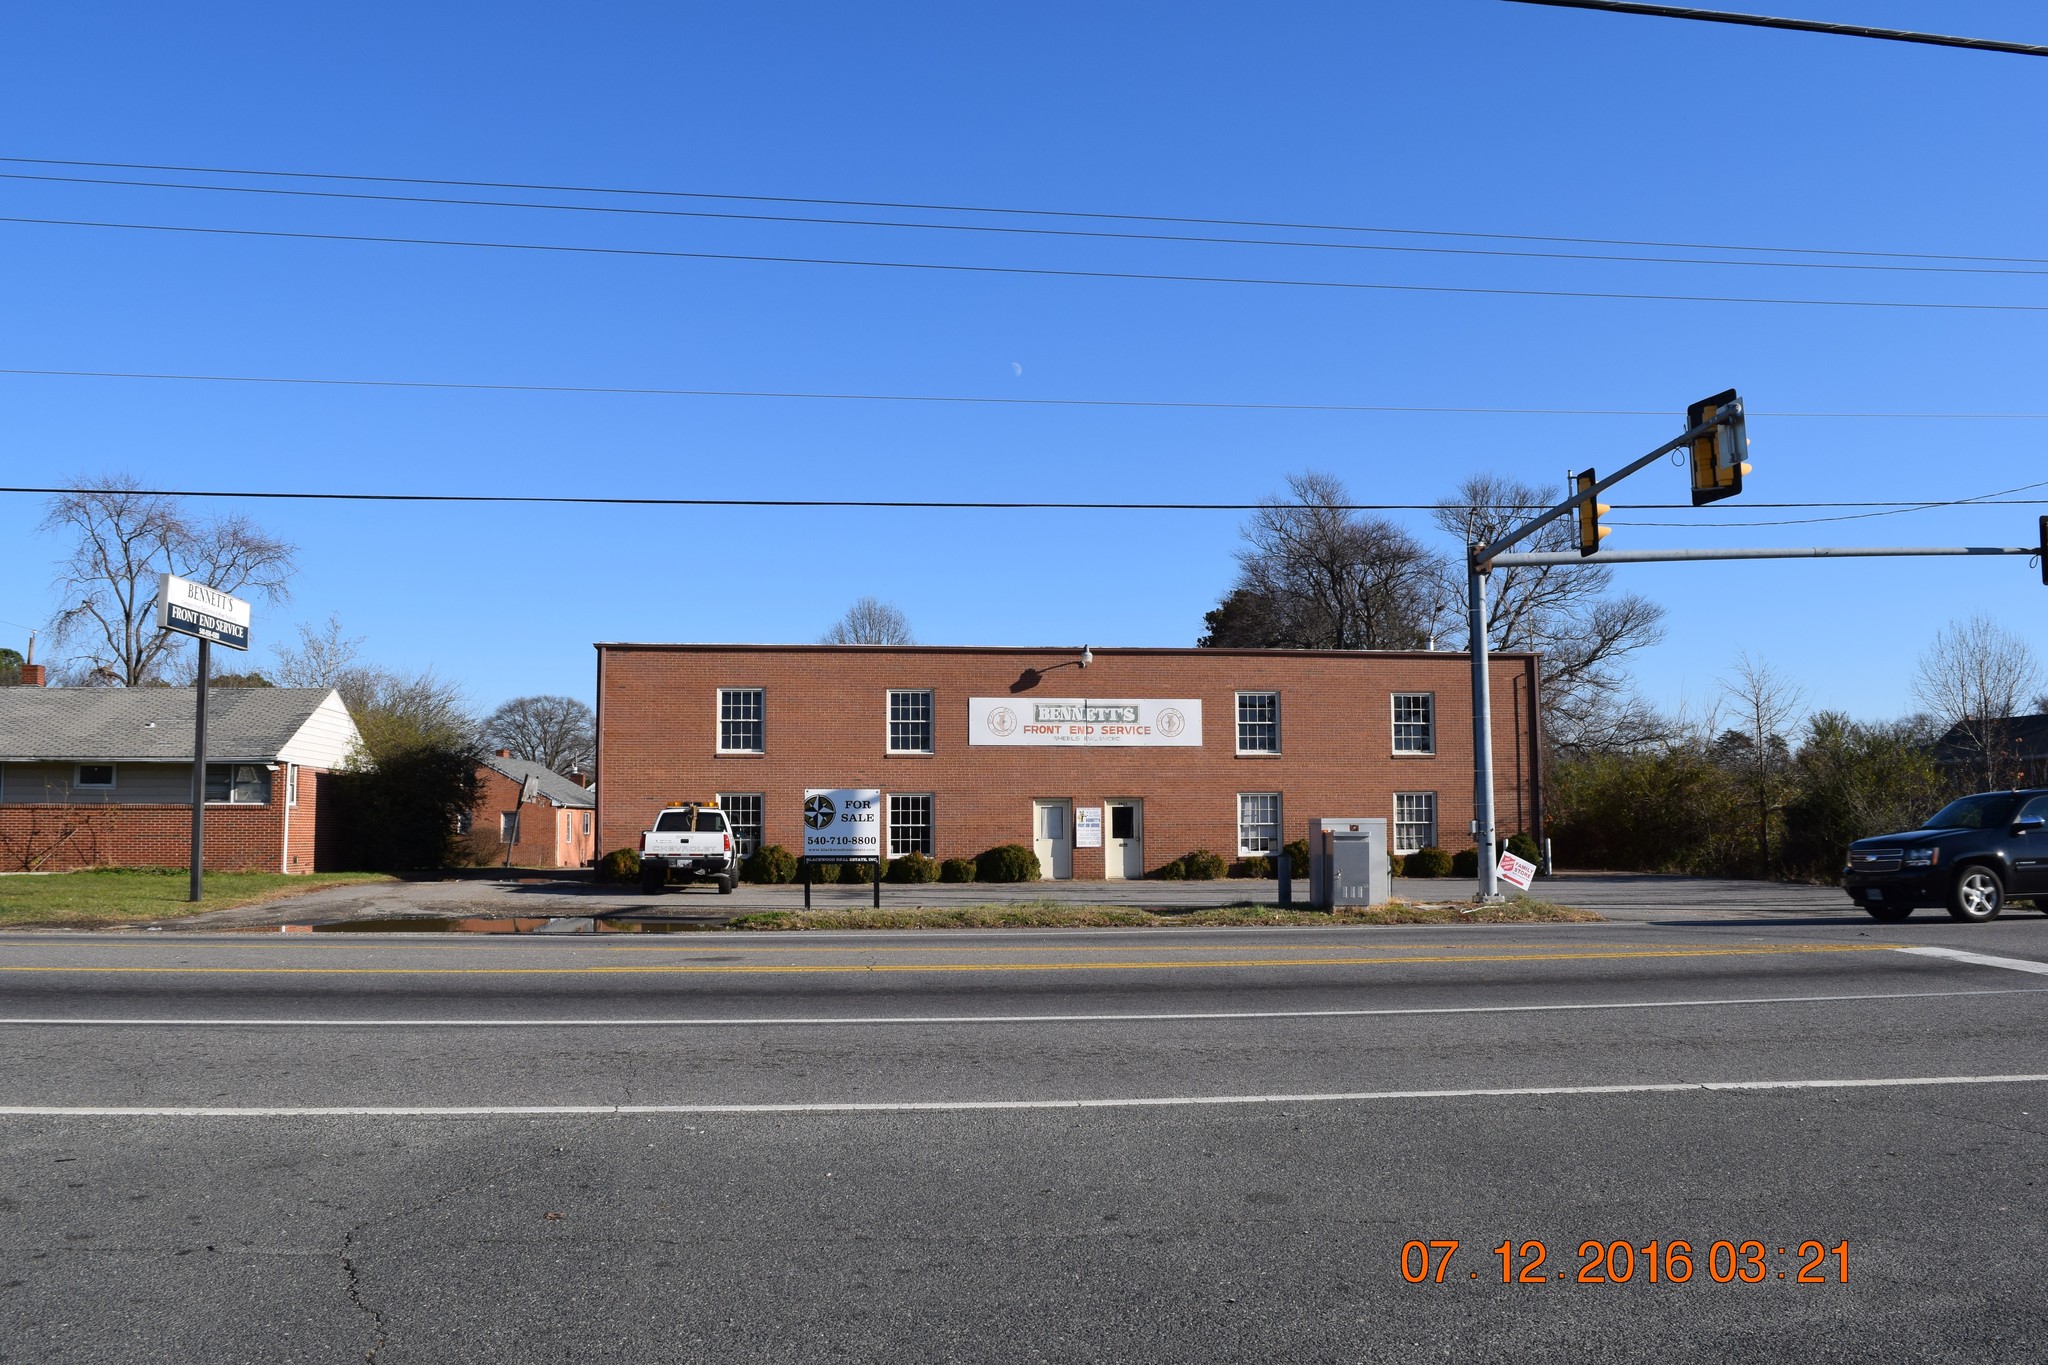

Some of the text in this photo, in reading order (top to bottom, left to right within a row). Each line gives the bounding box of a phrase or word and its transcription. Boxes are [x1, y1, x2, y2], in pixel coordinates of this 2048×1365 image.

[188, 583, 233, 611] BENNETT'S
[172, 605, 198, 624] FRONT
[199, 614, 215, 629] END
[215, 619, 244, 638] SERVICE
[1038, 707, 1135, 722] BENNETT'S
[1023, 725, 1152, 736] FRONT END SERVICE
[845, 800, 871, 809] FOR
[841, 813, 874, 822] SALE
[807, 836, 876, 845] 540-710-8800
[1514, 867, 1531, 879] STORE
[1515, 861, 1534, 874] FAMILY
